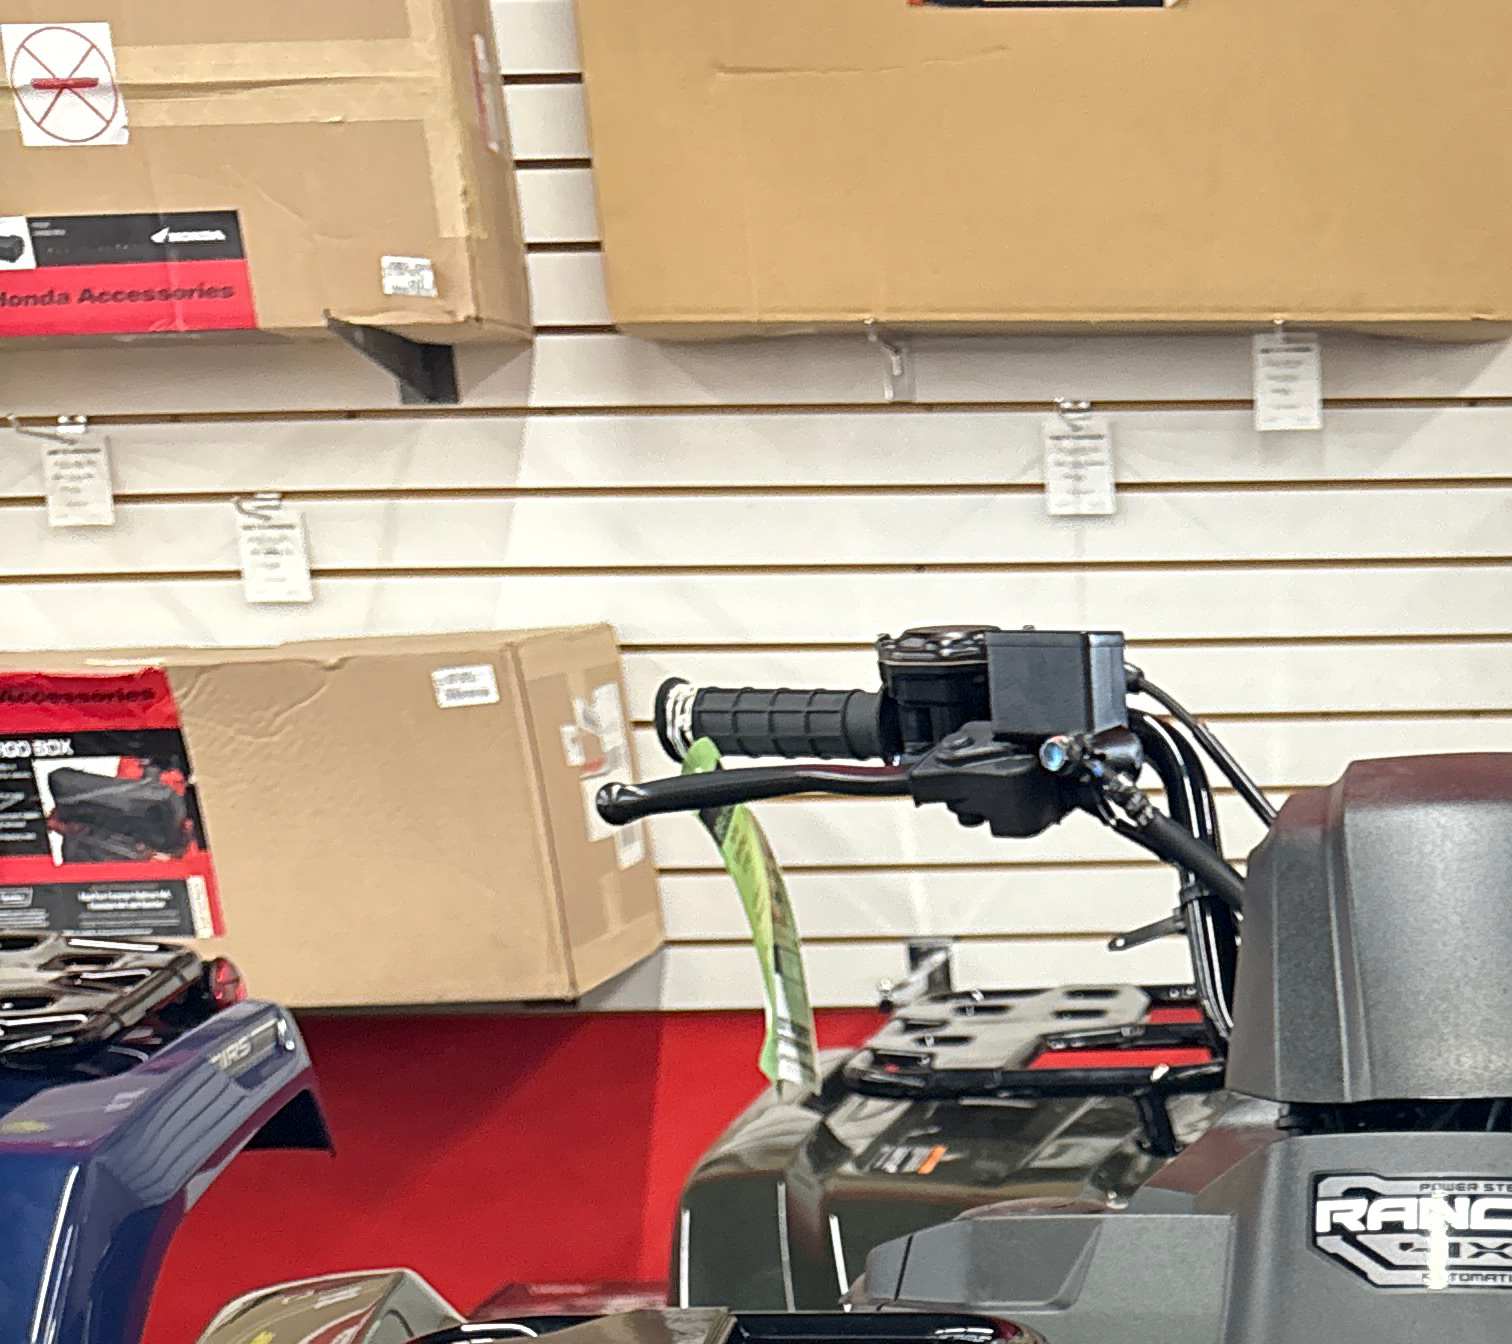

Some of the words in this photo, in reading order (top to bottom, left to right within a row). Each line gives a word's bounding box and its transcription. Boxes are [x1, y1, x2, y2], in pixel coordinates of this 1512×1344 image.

[79, 283, 233, 304] Accessories
[0, 739, 31, 758] GO
[1419, 1183, 1478, 1193] POWER
